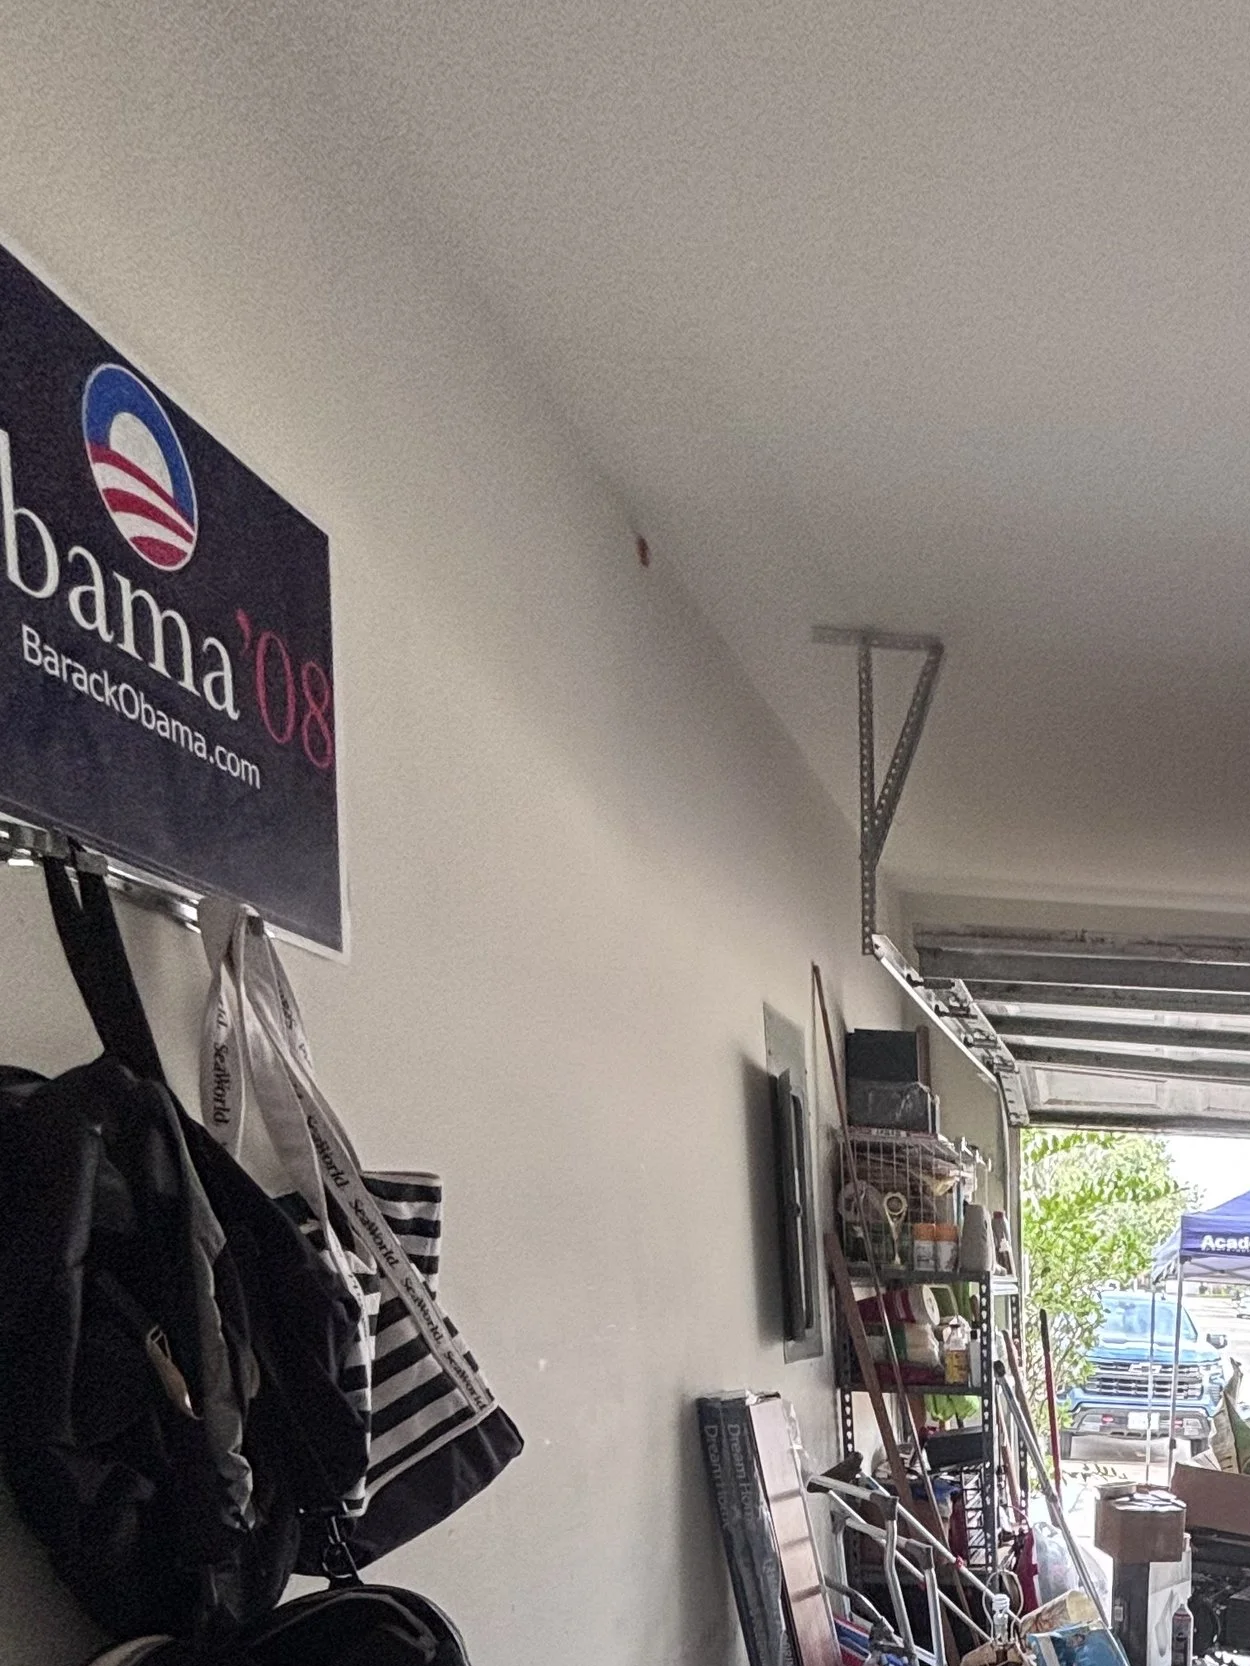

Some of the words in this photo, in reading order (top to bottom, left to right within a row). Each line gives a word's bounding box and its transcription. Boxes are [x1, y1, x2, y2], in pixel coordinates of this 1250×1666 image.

[21, 622, 261, 790] BarackObama.com
[213, 1041, 231, 1125] SeaWorld
[350, 1199, 400, 1268] SeaWorld
[403, 1276, 444, 1344] SeaWorld
[444, 1351, 487, 1411] SeaWorld
[727, 1422, 747, 1480] Dream
